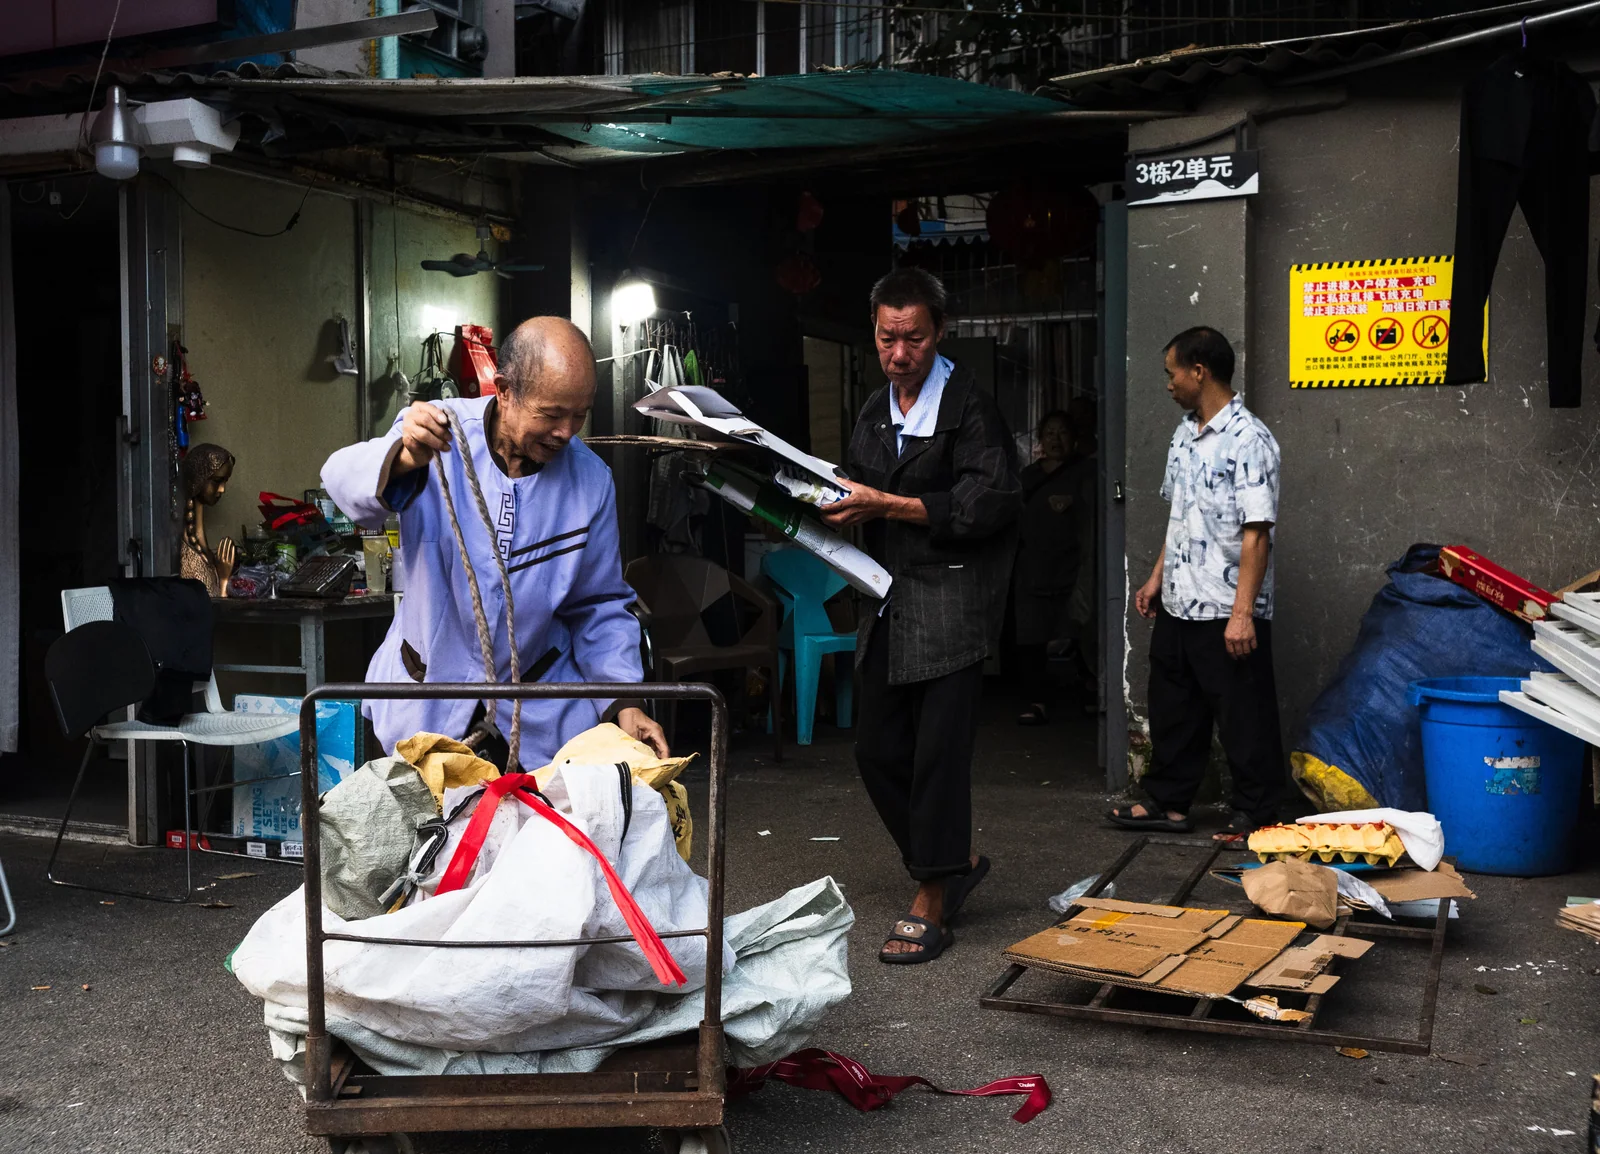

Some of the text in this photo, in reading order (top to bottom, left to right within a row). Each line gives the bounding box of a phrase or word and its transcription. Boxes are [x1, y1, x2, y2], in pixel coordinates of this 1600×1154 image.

[1135, 155, 1233, 185] 3栋2单元
[1303, 289, 1423, 305] 禁止私拉乱接飞线充电
[1303, 300, 1451, 317] 禁止非法改装 加强日常自查
[262, 800, 272, 827] SET
